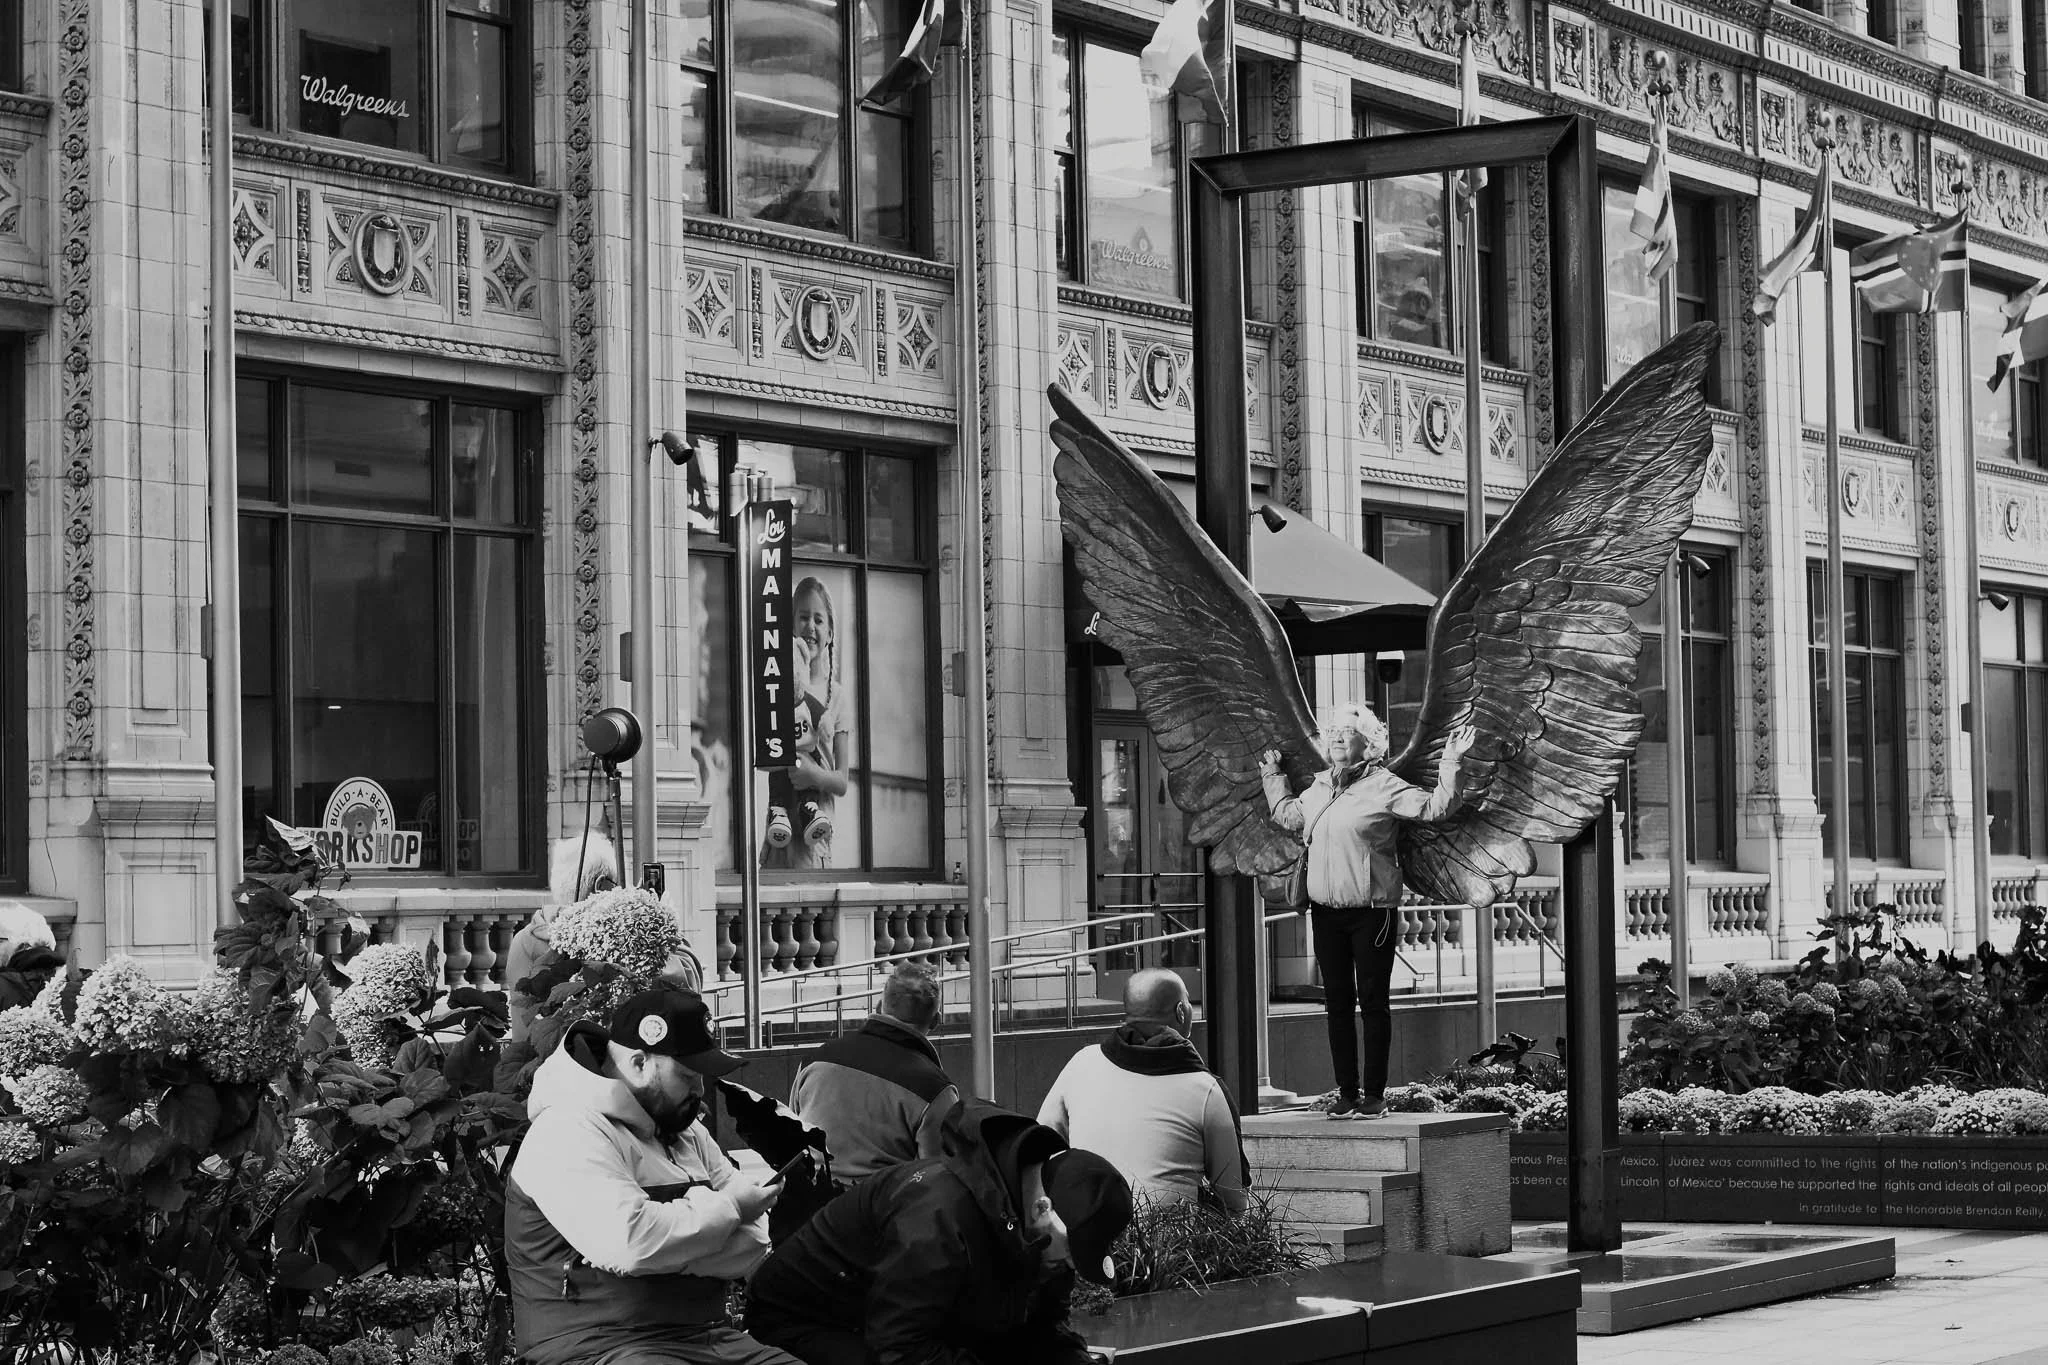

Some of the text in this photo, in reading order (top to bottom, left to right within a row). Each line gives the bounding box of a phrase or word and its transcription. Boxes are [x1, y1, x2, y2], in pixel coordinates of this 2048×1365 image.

[300, 74, 410, 118] Walgreens
[1099, 239, 1169, 271] Walgreens
[756, 508, 786, 545] Lou
[761, 548, 784, 758] MALNATI'S
[303, 829, 420, 865] RKSHOP
[1668, 1155, 1705, 1168] Juárez
[1709, 1158, 1732, 1168] was
[1736, 1157, 1800, 1169] committed
[1805, 1158, 1817, 1169] to
[1822, 1158, 1841, 1169] the
[1845, 1157, 1877, 1171] rights
[1884, 1158, 1896, 1169] of
[1900, 1158, 1919, 1170] the
[1922, 1158, 1967, 1171] nation's
[1970, 1159, 2032, 1173] indigenous
[1523, 1175, 1552, 1186] been
[1620, 1175, 1660, 1188] Lincoln
[1668, 1176, 1680, 1188] of
[1728, 1177, 1778, 1190] because
[1780, 1177, 1795, 1189] he
[1797, 1179, 1856, 1192] supported
[1858, 1179, 1877, 1190] the
[1884, 1179, 1915, 1193] rights
[1918, 1180, 1942, 1192] and
[1945, 1180, 1979, 1192] ideals
[1982, 1180, 1995, 1192] of
[1997, 1180, 2011, 1192] all
[1811, 1203, 1862, 1215] gratitude
[1866, 1204, 1878, 1214] to
[1885, 1204, 1903, 1214] the
[1906, 1205, 1963, 1216] Honorable
[1966, 1205, 2012, 1216] Brendan
[2015, 1206, 2047, 1219] Reilly.
